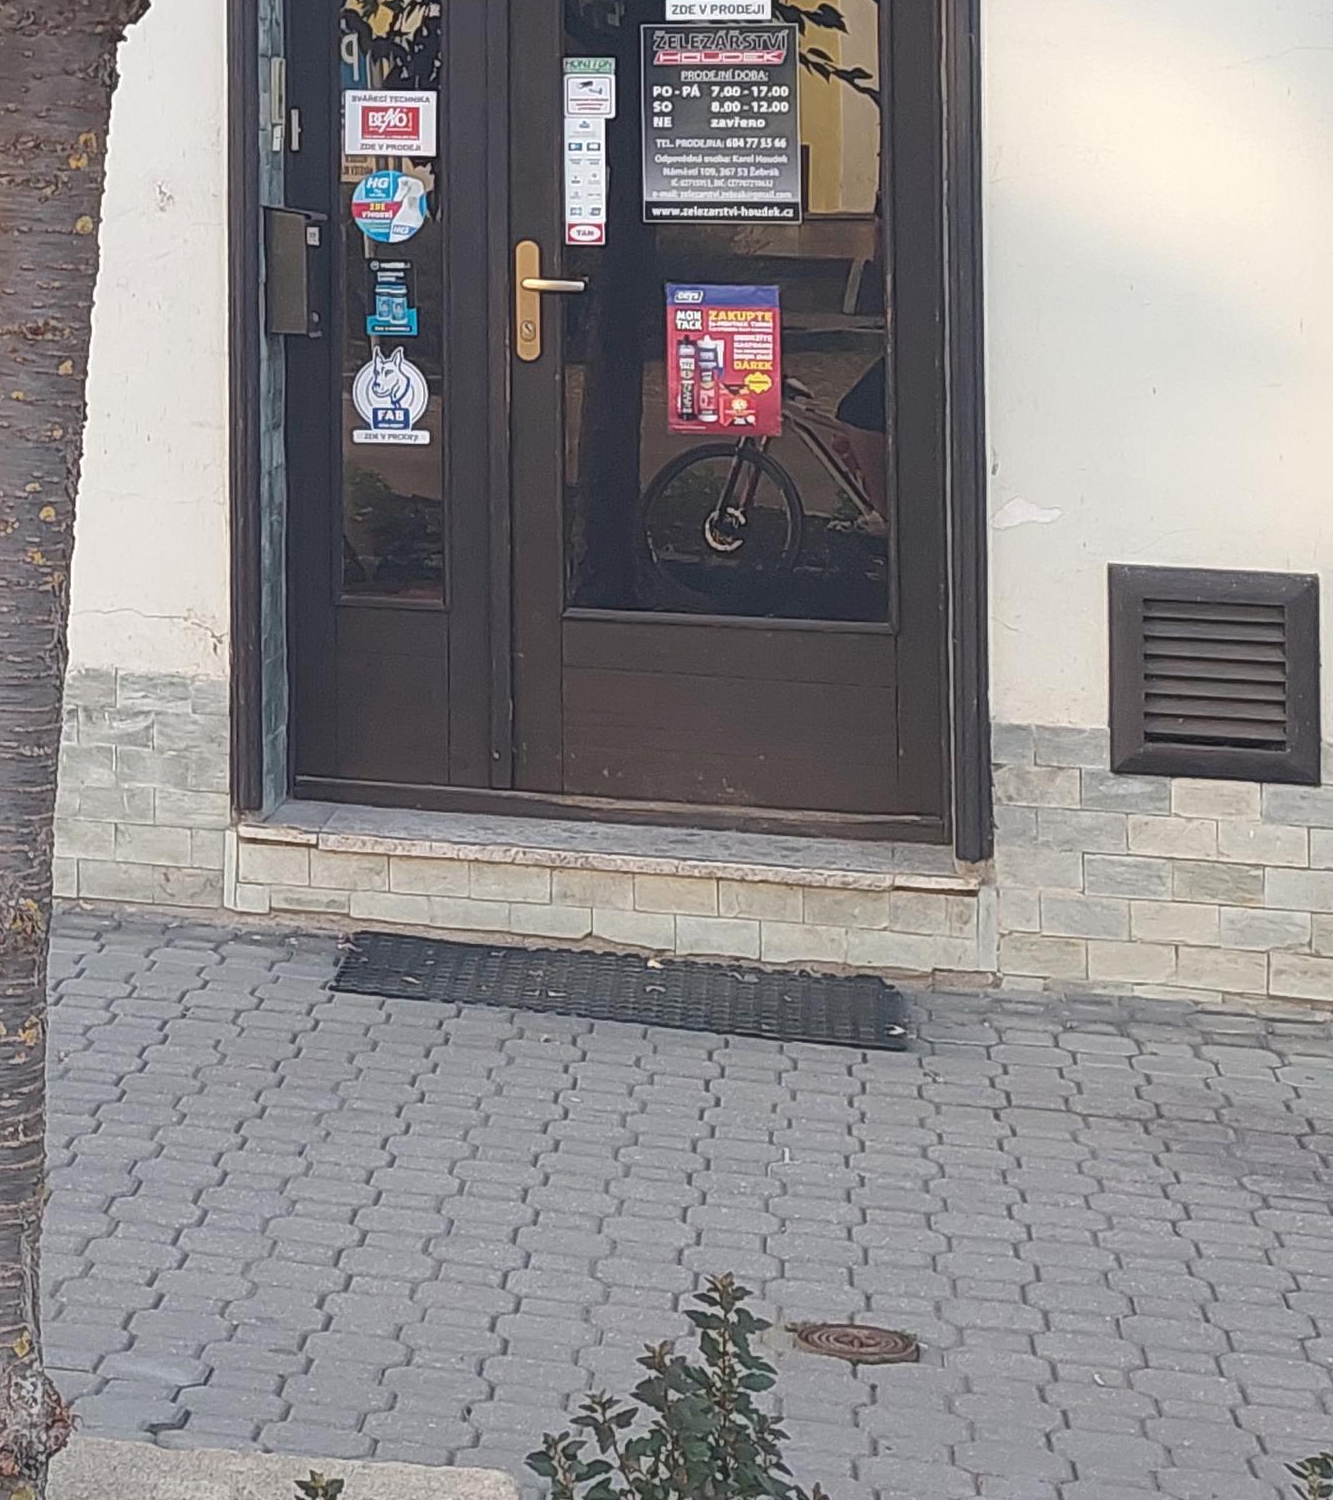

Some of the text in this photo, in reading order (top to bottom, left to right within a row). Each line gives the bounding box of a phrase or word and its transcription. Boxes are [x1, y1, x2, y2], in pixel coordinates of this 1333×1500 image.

[672, 5, 695, 15] ZDE
[699, 4, 707, 14] V
[653, 30, 788, 50] ŽELEZÁŘSTVÍ
[659, 52, 784, 62] HOUDEK
[681, 70, 769, 81] PRODEJNÍ DOBA:
[653, 84, 789, 97] PO PÁ 7.00 17.00
[653, 101, 789, 112] SO 8.00 12.00
[653, 117, 765, 128] NE zavřeno
[367, 178, 389, 188] HG
[378, 410, 404, 421] FAB
